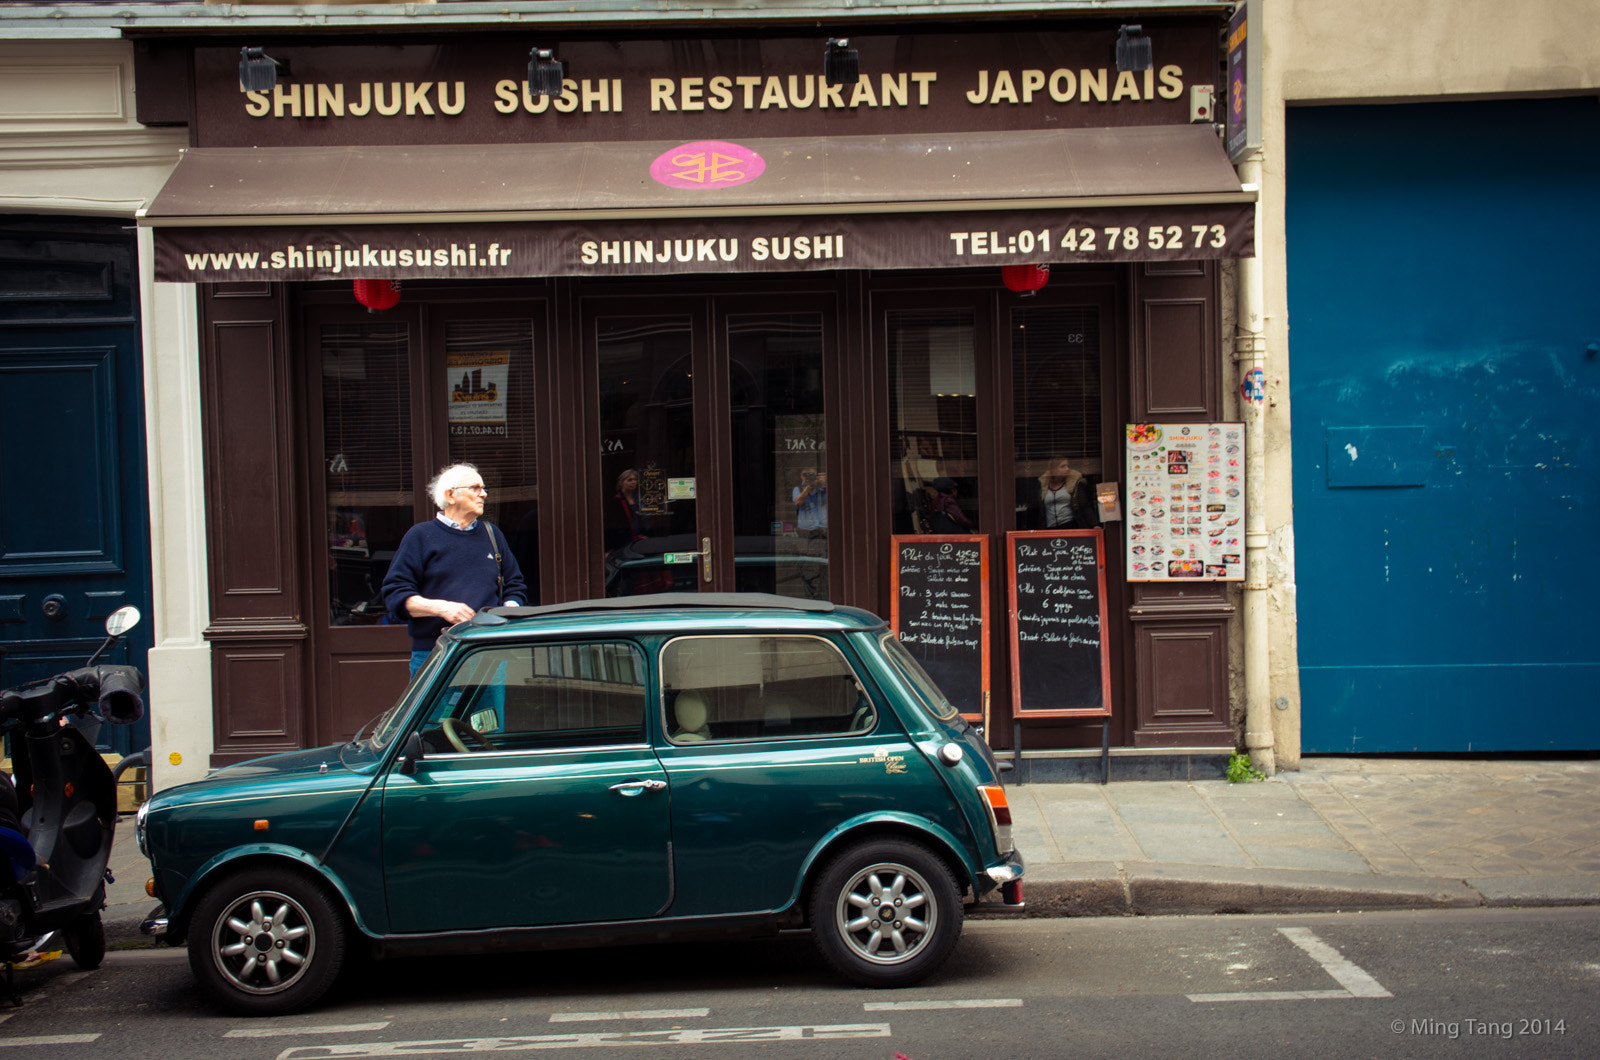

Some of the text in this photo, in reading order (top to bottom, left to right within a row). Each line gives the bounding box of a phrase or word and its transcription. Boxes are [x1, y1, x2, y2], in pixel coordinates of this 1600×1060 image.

[245, 65, 1184, 117] SHINJUKU SUSHI RESTAURANT JAPONAIS
[581, 235, 845, 265] SHINJUKU SUSHI
[951, 224, 1227, 256] TEL:01 42 78 52 73
[184, 241, 512, 275] www.shinjukusushi.fr
[1042, 598, 1049, 608] 6
